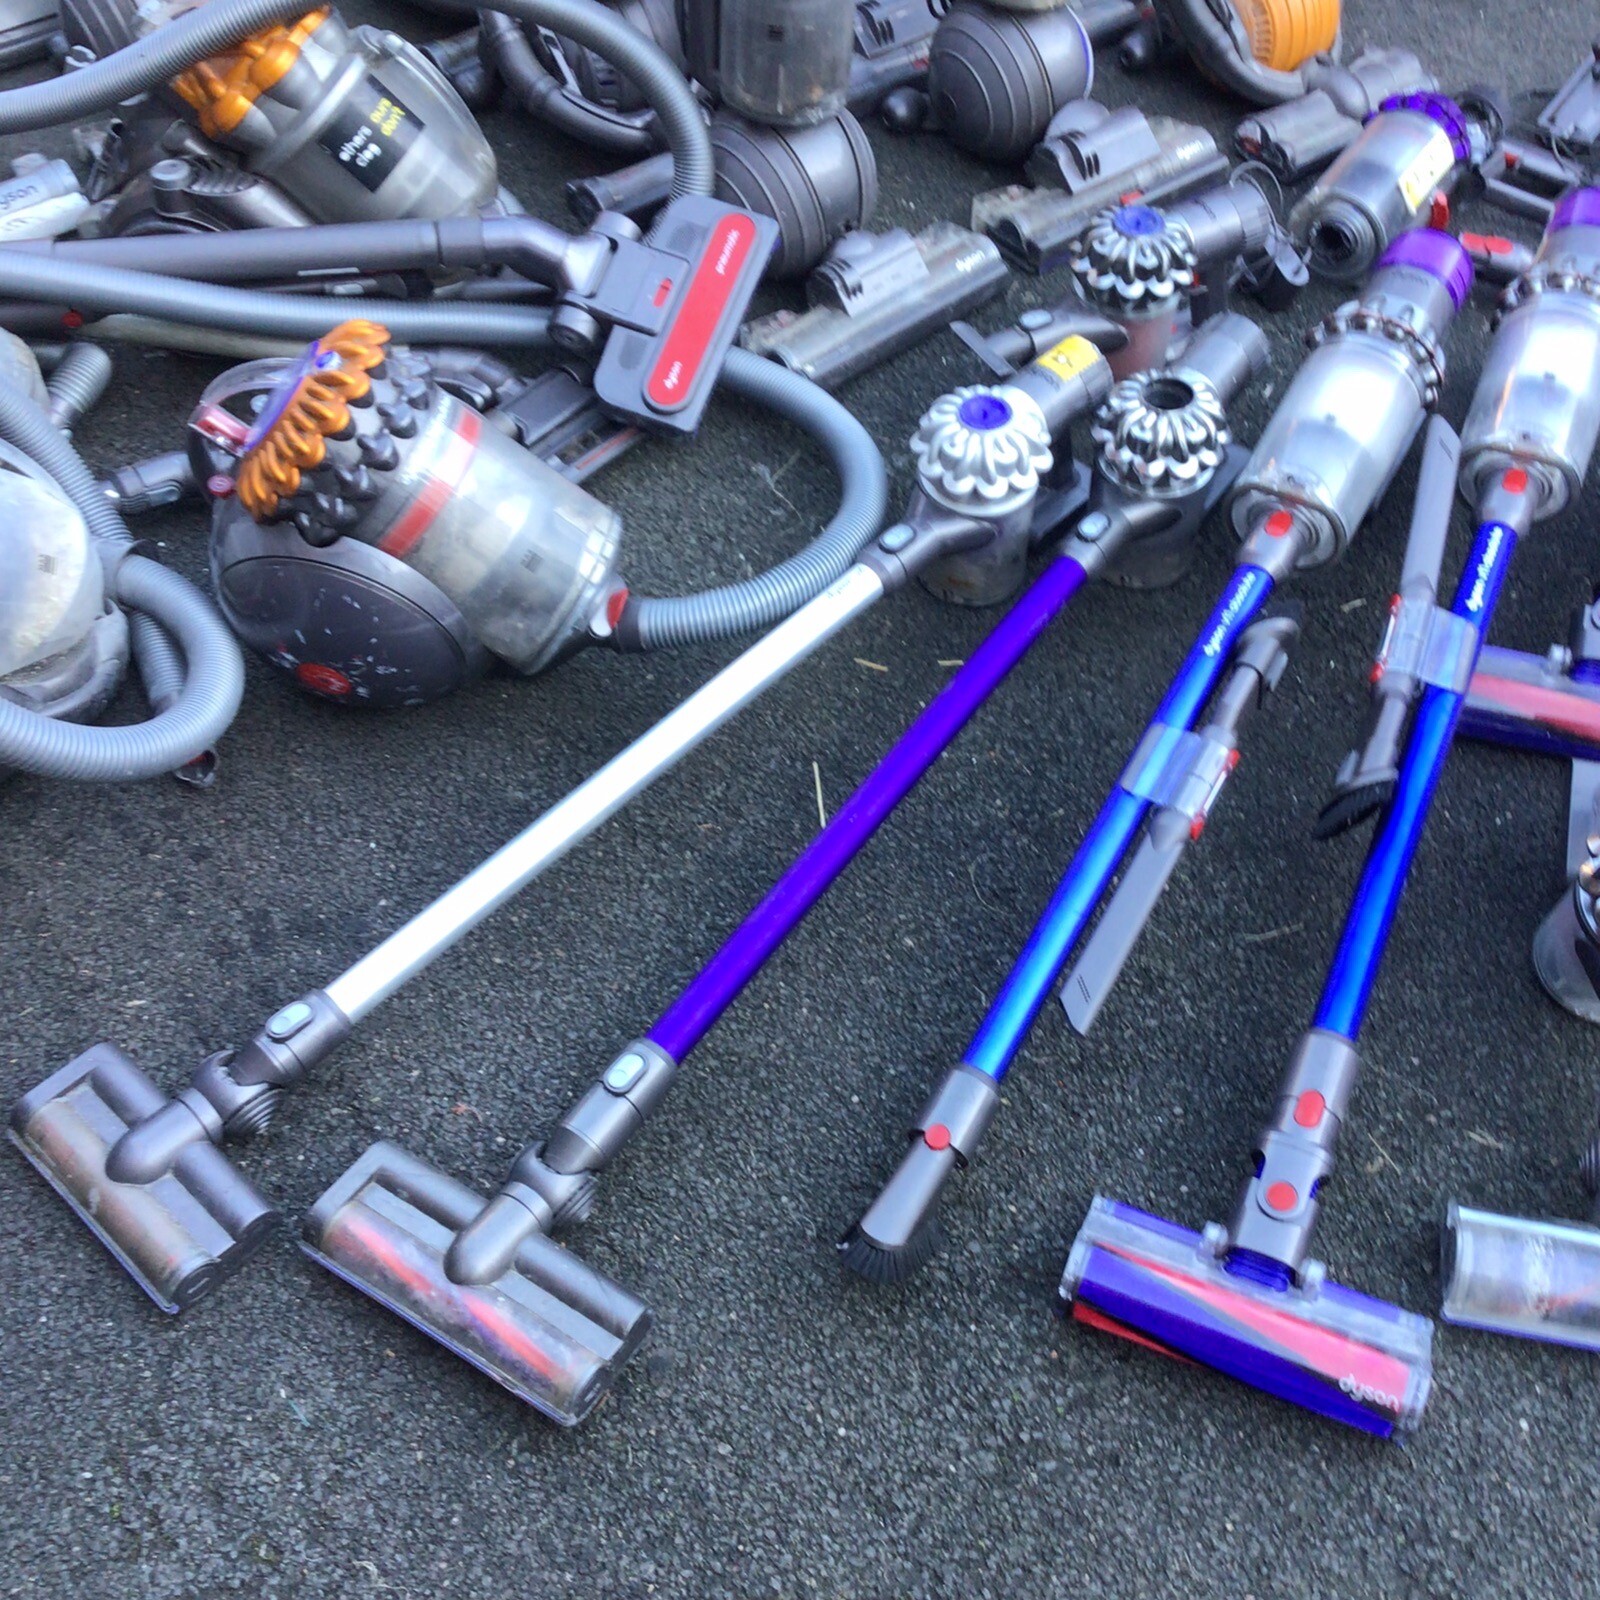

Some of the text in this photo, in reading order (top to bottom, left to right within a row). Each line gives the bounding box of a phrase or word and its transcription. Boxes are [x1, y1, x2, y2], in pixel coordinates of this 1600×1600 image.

[369, 97, 392, 124] ours
[338, 125, 373, 162] others
[355, 142, 382, 168] clog
[955, 248, 986, 273] dyson
[662, 360, 684, 390] dyson
[1465, 579, 1487, 613] dyson
[1202, 624, 1229, 657] dyson
[1338, 1372, 1400, 1415] dyson
